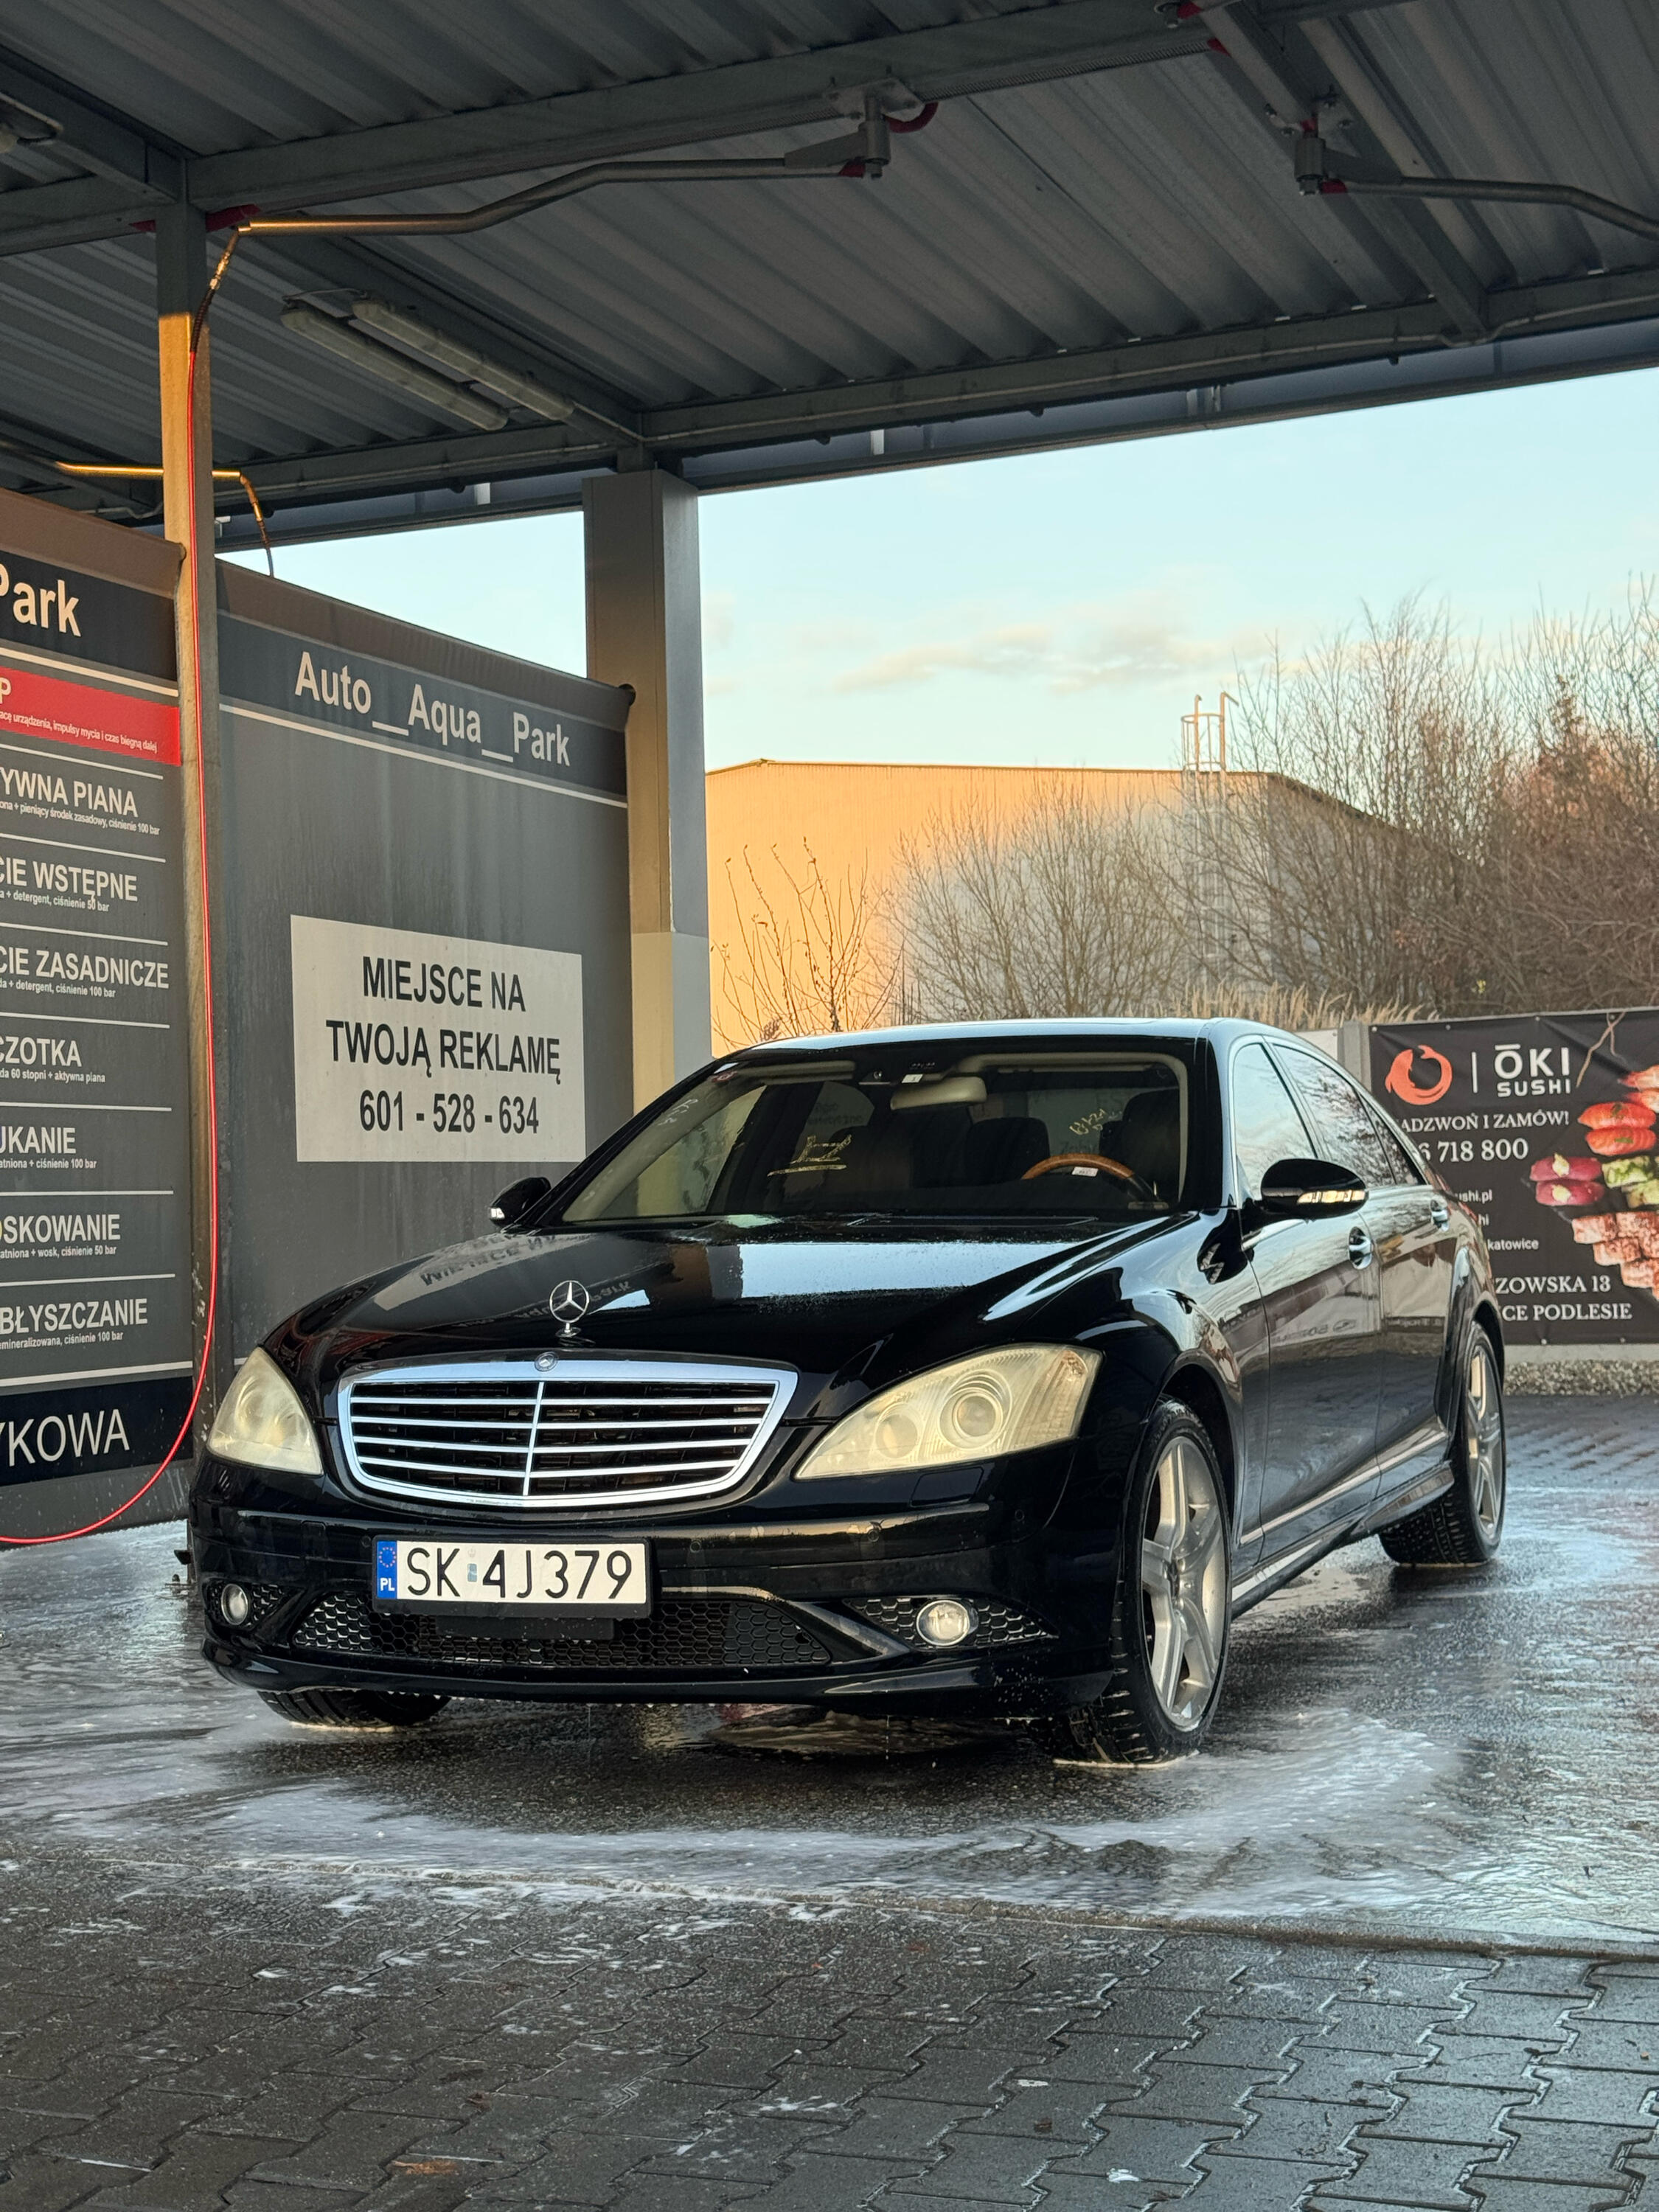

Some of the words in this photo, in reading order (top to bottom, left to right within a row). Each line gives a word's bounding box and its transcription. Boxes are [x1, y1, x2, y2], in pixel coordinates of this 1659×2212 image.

[80, 728, 100, 740] mycia
[105, 734, 119, 743] czas
[120, 735, 142, 751] biegną
[142, 740, 158, 754] dalej
[0, 766, 69, 805] YWNA
[74, 781, 139, 818] PIANA
[20, 804, 49, 818] pieniący
[50, 807, 73, 821] środek
[74, 813, 108, 828] zasadowy,
[108, 818, 136, 832] ciśnienie
[138, 822, 148, 832] 100
[150, 824, 160, 835] bar
[32, 861, 138, 902] WSTĘPNE
[13, 890, 52, 905] detergent,
[53, 896, 86, 909] ciśnienie
[87, 899, 96, 910] 50
[97, 901, 109, 912] bar
[36, 950, 169, 989] ZASADNICZE
[15, 980, 54, 994] detergent,
[55, 984, 88, 995] ciśnienie
[89, 986, 102, 996] 100
[103, 987, 116, 998] bar
[363, 956, 481, 1008] MIEJSCE
[492, 972, 526, 1012] NA
[326, 1020, 432, 1079] TWOJĄ
[440, 1029, 561, 1084] REKLAMĘ
[11, 1068, 20, 1079] 60
[22, 1070, 46, 1082] stopni
[55, 1071, 84, 1083] aktywna
[86, 1072, 105, 1084] piana
[1497, 1079, 1571, 1097] SUSHI
[360, 1091, 405, 1131] 601
[433, 1093, 476, 1134] 528
[498, 1096, 539, 1134] 634
[1397, 1112, 1479, 1133] ADZWOŃ
[1493, 1109, 1569, 1130] ZAMÓW!
[1437, 1140, 1474, 1163] 718
[1481, 1138, 1529, 1161] 800
[36, 1158, 69, 1169] ciśnienie
[71, 1158, 83, 1169] 100
[85, 1158, 97, 1169] bar
[0, 1214, 121, 1244] SKOWANIE
[38, 1247, 59, 1259] wosk,
[61, 1245, 93, 1256] ciśnienie
[94, 1245, 103, 1255] 50
[105, 1245, 116, 1255] bar
[1487, 1237, 1540, 1251] katowice
[1500, 1304, 1528, 1321] CE
[1533, 1303, 1633, 1321] PODLESIE
[0, 1335, 62, 1350] mineralizowana,
[64, 1332, 96, 1344] ciśnienie
[98, 1331, 110, 1341] 100
[112, 1331, 123, 1340] bar
[0, 1409, 130, 1467] KOWA
[380, 1577, 395, 1592] PL
[407, 1547, 460, 1597] SK
[481, 1549, 633, 1599] 4J379
